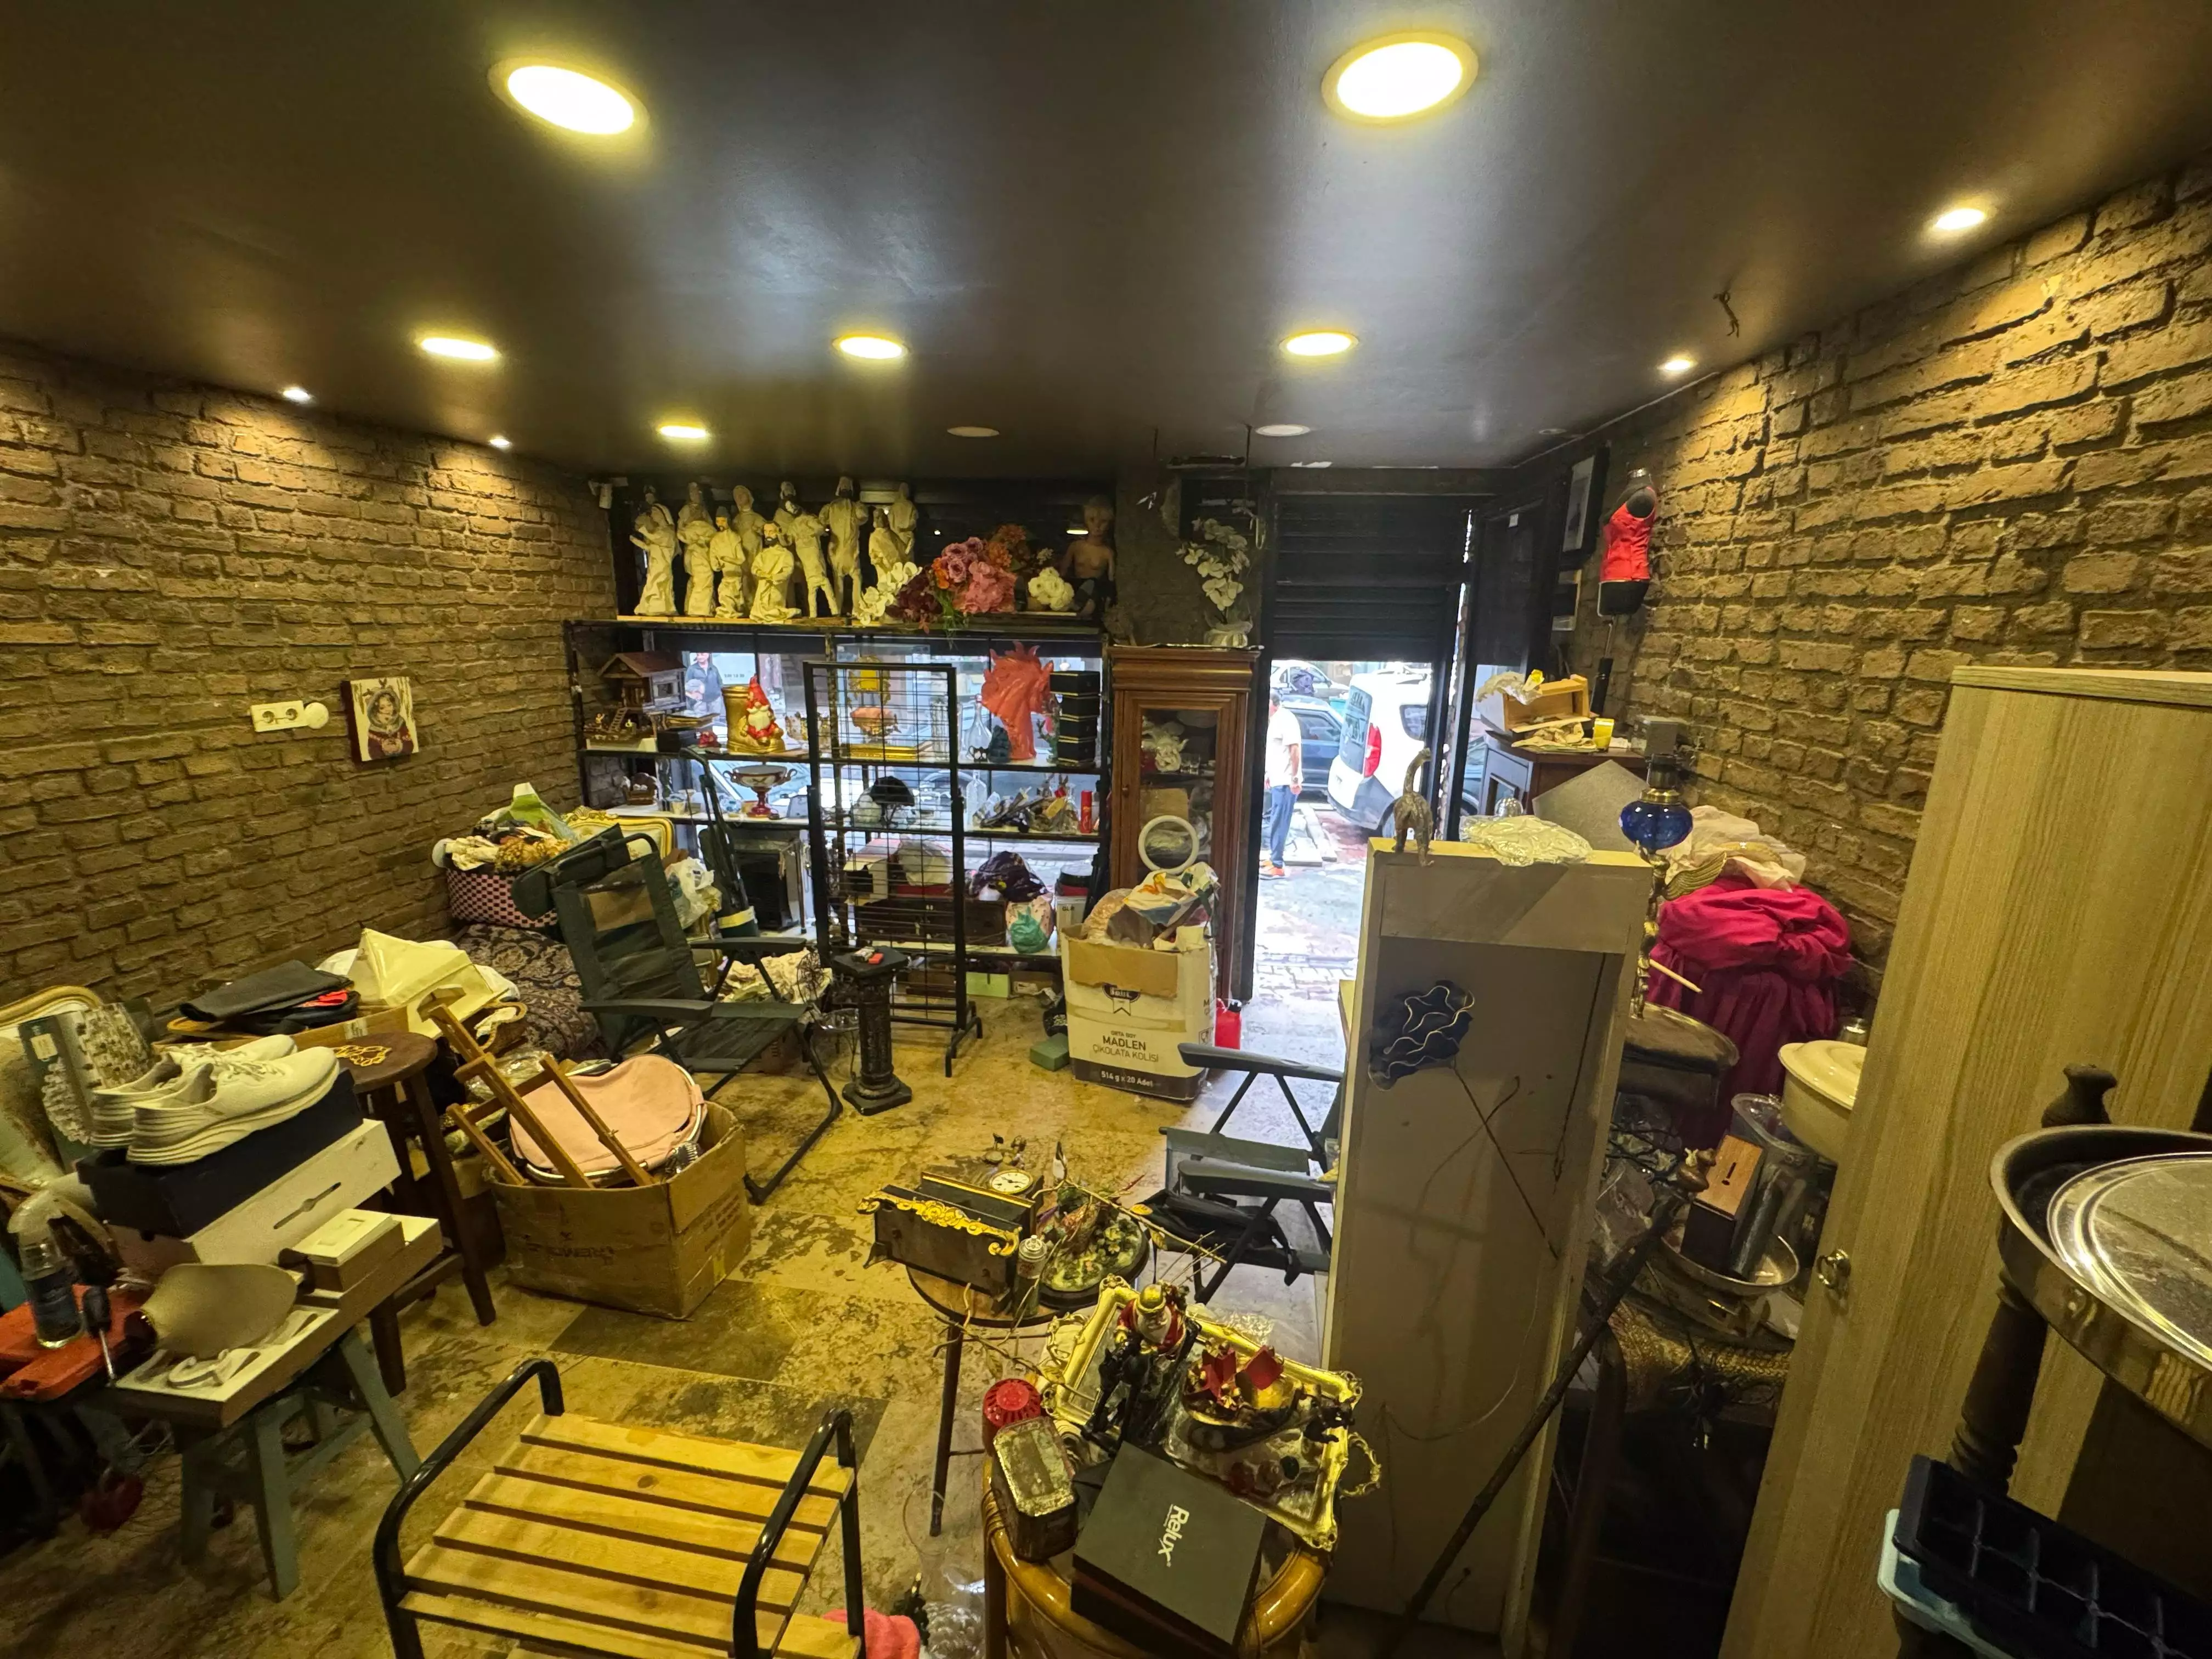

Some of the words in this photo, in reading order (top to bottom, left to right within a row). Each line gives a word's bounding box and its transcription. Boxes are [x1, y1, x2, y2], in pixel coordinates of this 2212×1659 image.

[1103, 1035, 1146, 1051] MADLEN
[1101, 1070, 1114, 1080] 514
[1127, 1075, 1136, 1084] 20
[1137, 1077, 1154, 1088] Adet
[1158, 1505, 1190, 1562] Relux
